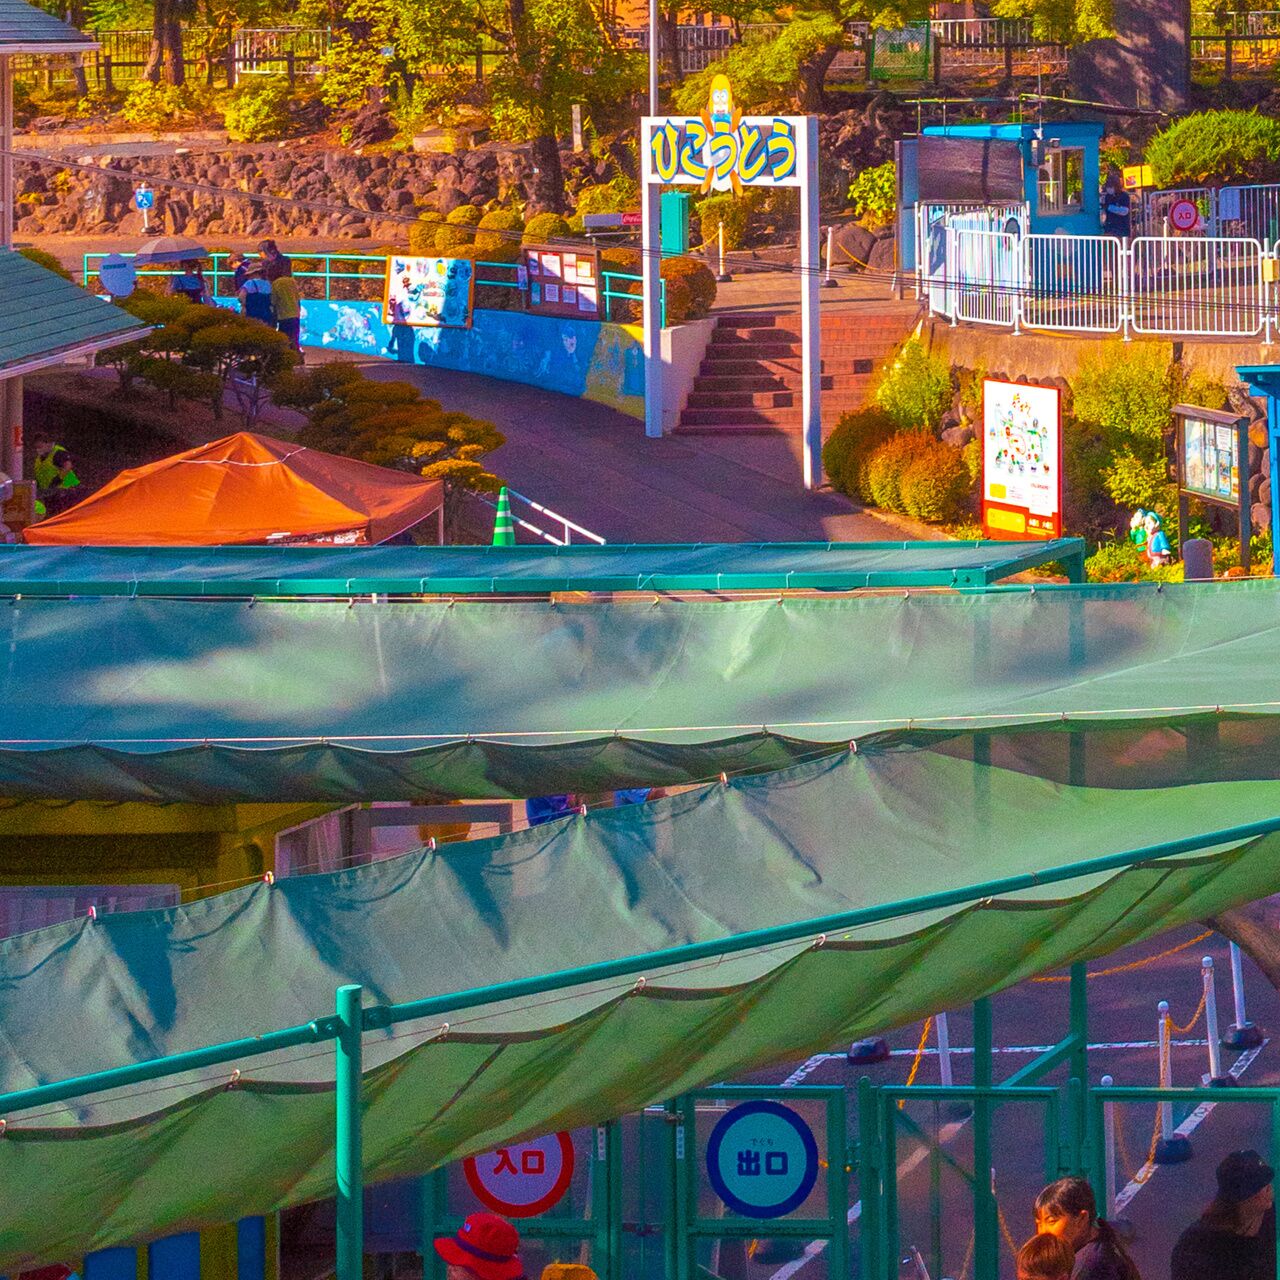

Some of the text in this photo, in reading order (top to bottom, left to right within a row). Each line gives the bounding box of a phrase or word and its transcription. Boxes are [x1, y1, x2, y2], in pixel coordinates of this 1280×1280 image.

[650, 118, 797, 184] ひこうとう
[1178, 212, 1192, 220] 入口
[493, 1148, 545, 1176] 入口
[737, 1149, 789, 1177] 出口
